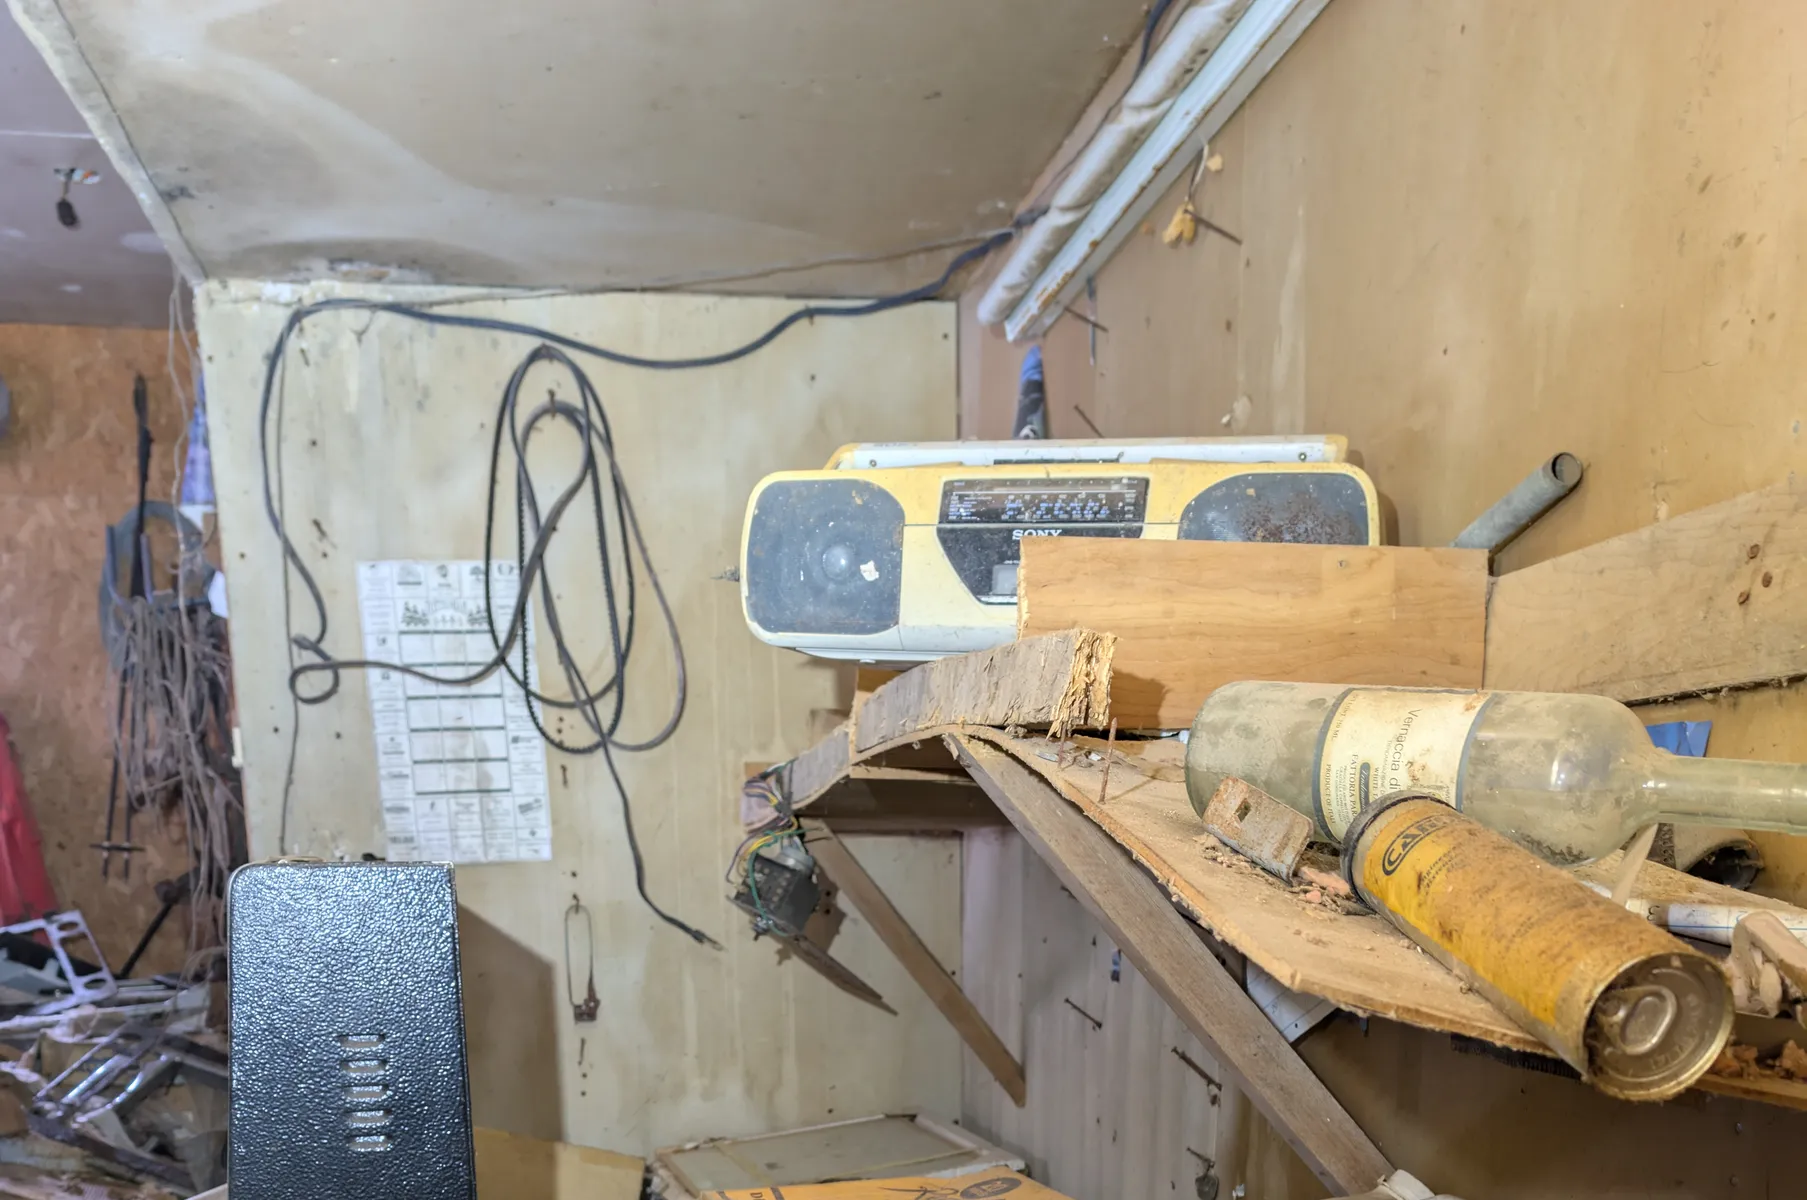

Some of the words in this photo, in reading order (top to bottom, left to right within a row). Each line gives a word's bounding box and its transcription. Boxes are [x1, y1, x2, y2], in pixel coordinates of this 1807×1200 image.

[1012, 529, 1062, 541] SONY
[1391, 708, 1423, 772] Vernaccia
[1348, 754, 1359, 799] FATTORIA
